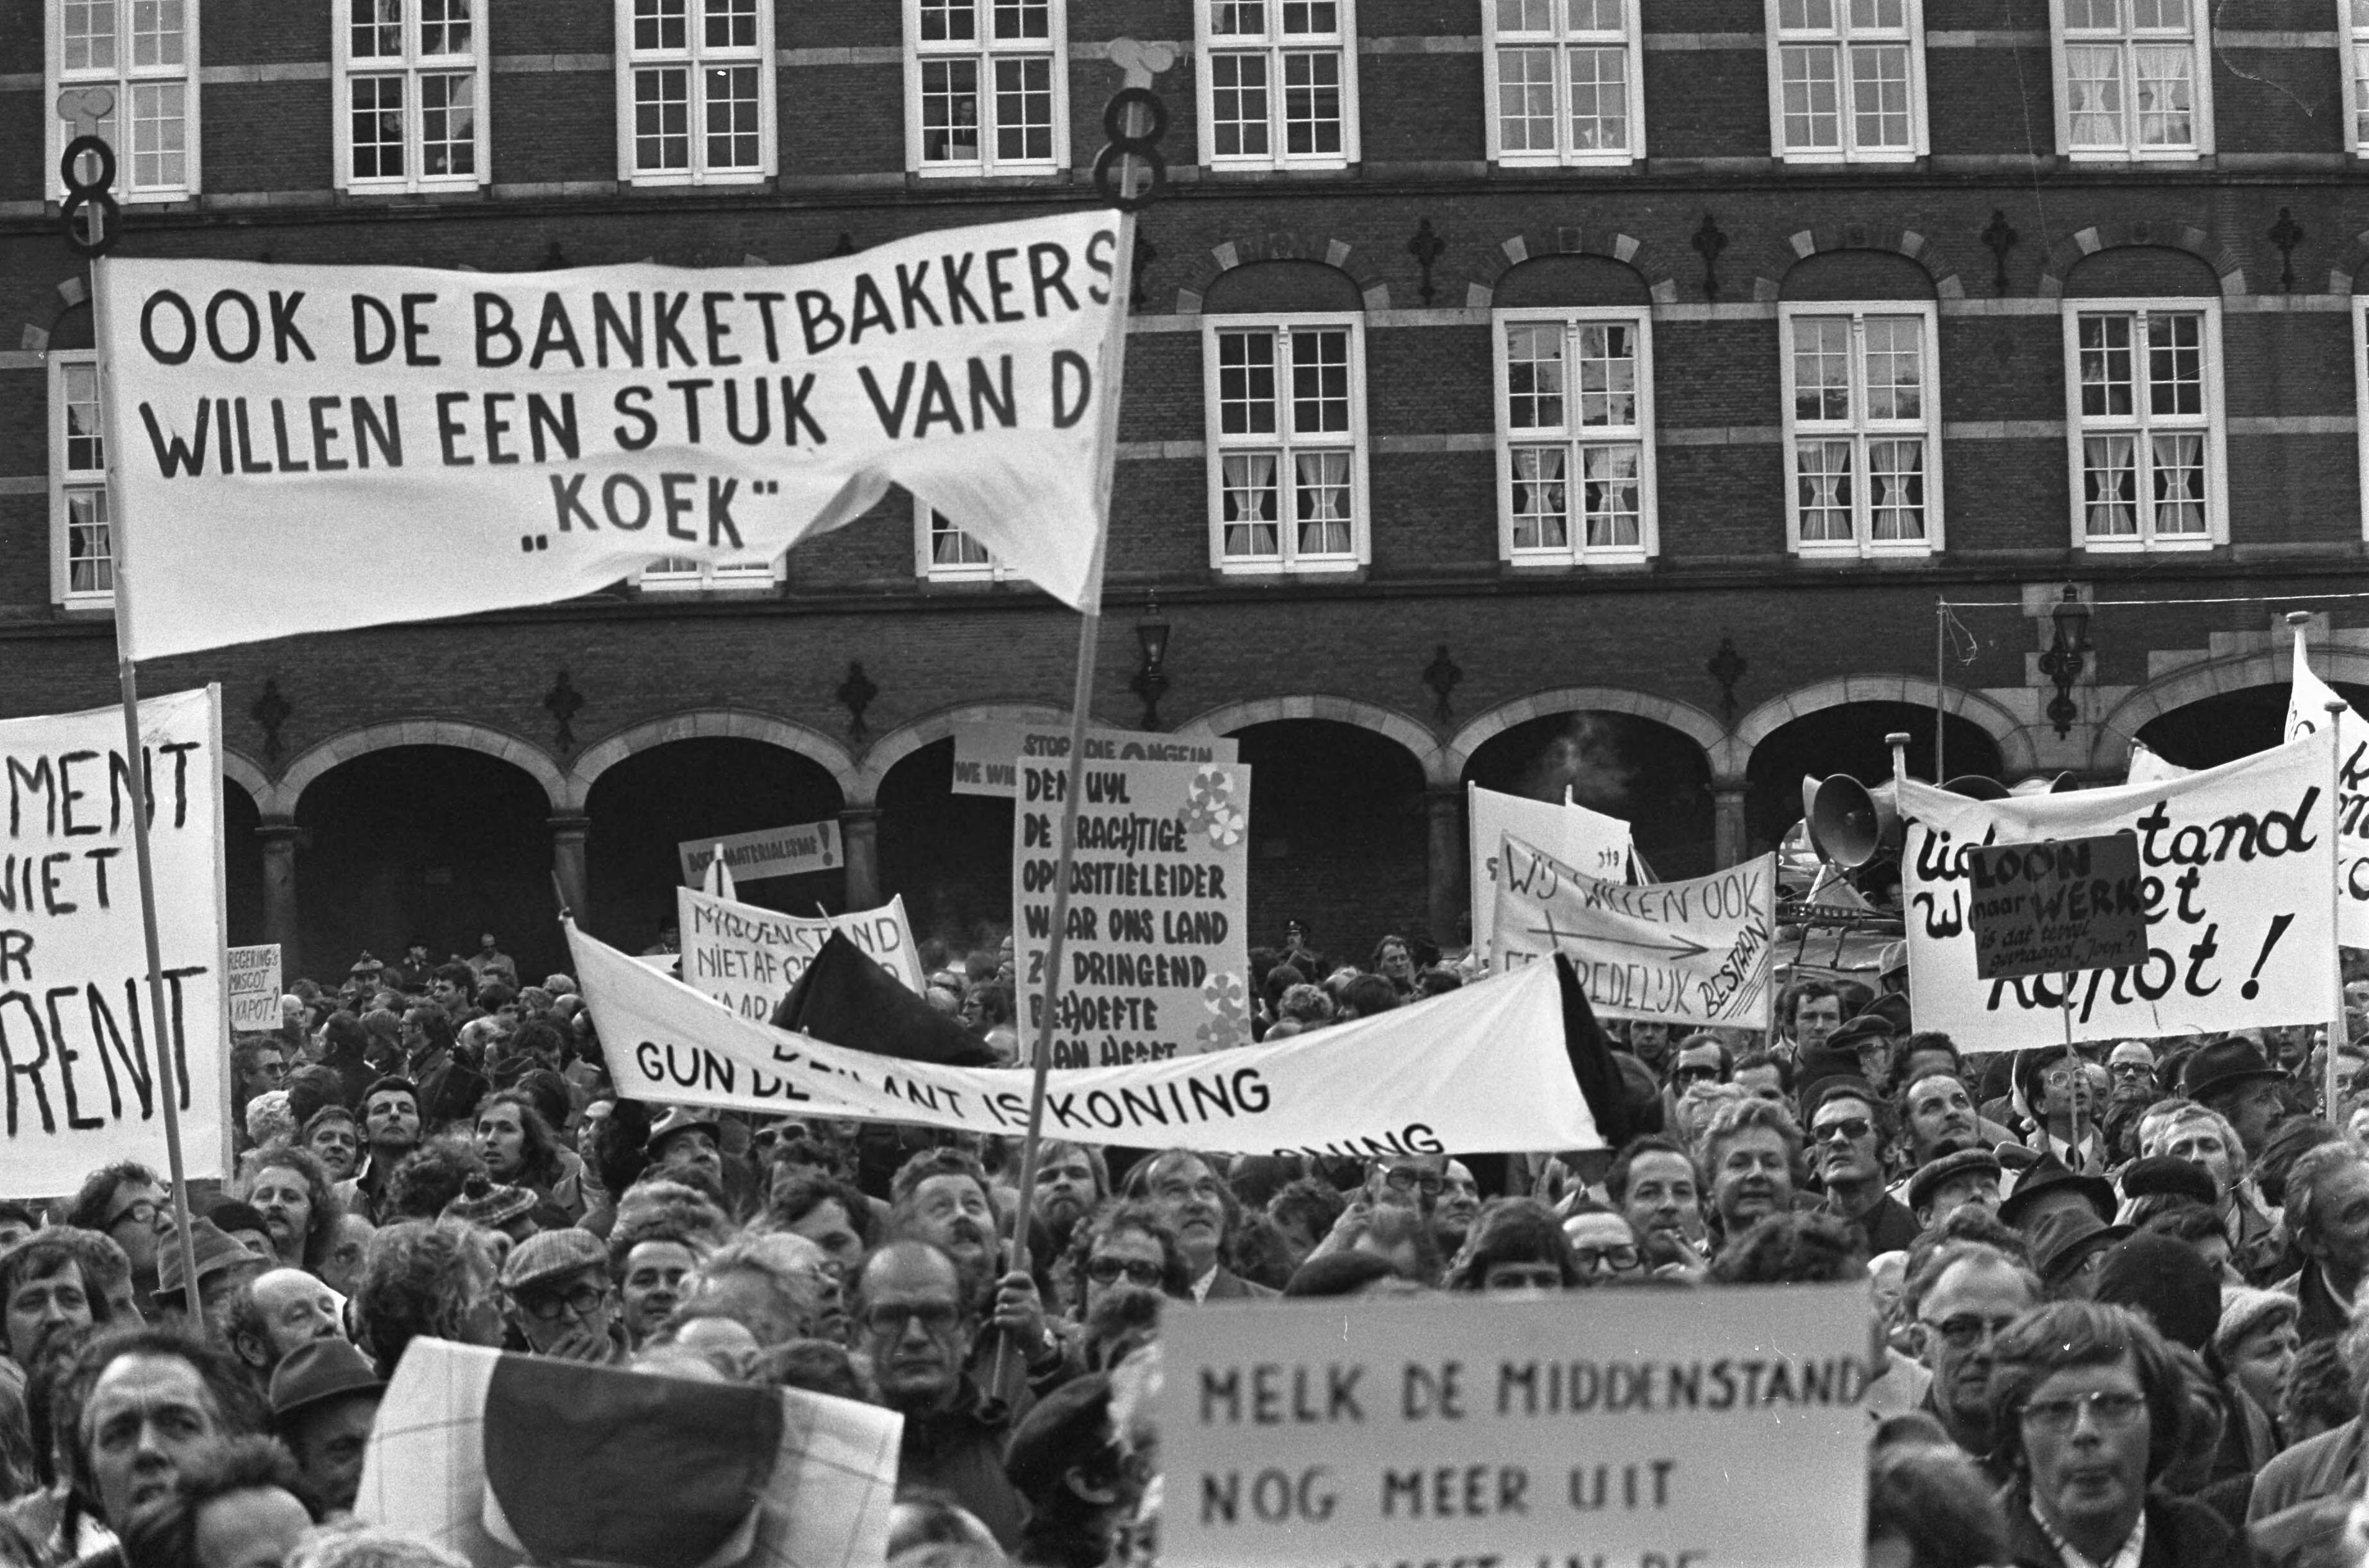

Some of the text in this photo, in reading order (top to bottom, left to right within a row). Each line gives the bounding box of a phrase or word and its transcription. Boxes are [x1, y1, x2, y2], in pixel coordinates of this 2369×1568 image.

[140, 230, 1117, 369] OOK DE BANKETBAKKERS
[138, 396, 403, 478] WILLEN
[436, 391, 581, 466] EEN
[613, 373, 828, 451] STUK
[858, 354, 1018, 439] VAN
[1023, 733, 1071, 758] STOP
[6, 741, 201, 838] MENT
[954, 761, 982, 784] WE
[1085, 771, 1131, 804] UYL
[1024, 812, 1188, 858] DE RACHTIGE
[1971, 842, 2091, 889] LOON
[1703, 872, 1764, 920] OOK
[1974, 895, 2025, 921] naar
[2030, 873, 2141, 923] WERK
[1024, 905, 1228, 945] WAR ONS LAND
[697, 943, 749, 979] NIET
[1072, 950, 1207, 988] DRINGEND
[1697, 916, 1769, 1019] BESTAAN
[636, 1041, 734, 1093] GUN
[982, 1093, 1030, 1127] IS
[1046, 1068, 1270, 1129] KONING
[1198, 1357, 1871, 1426] MELK DE MIDDENSTAND
[1200, 1458, 1677, 1526] NOG MEER UIT
